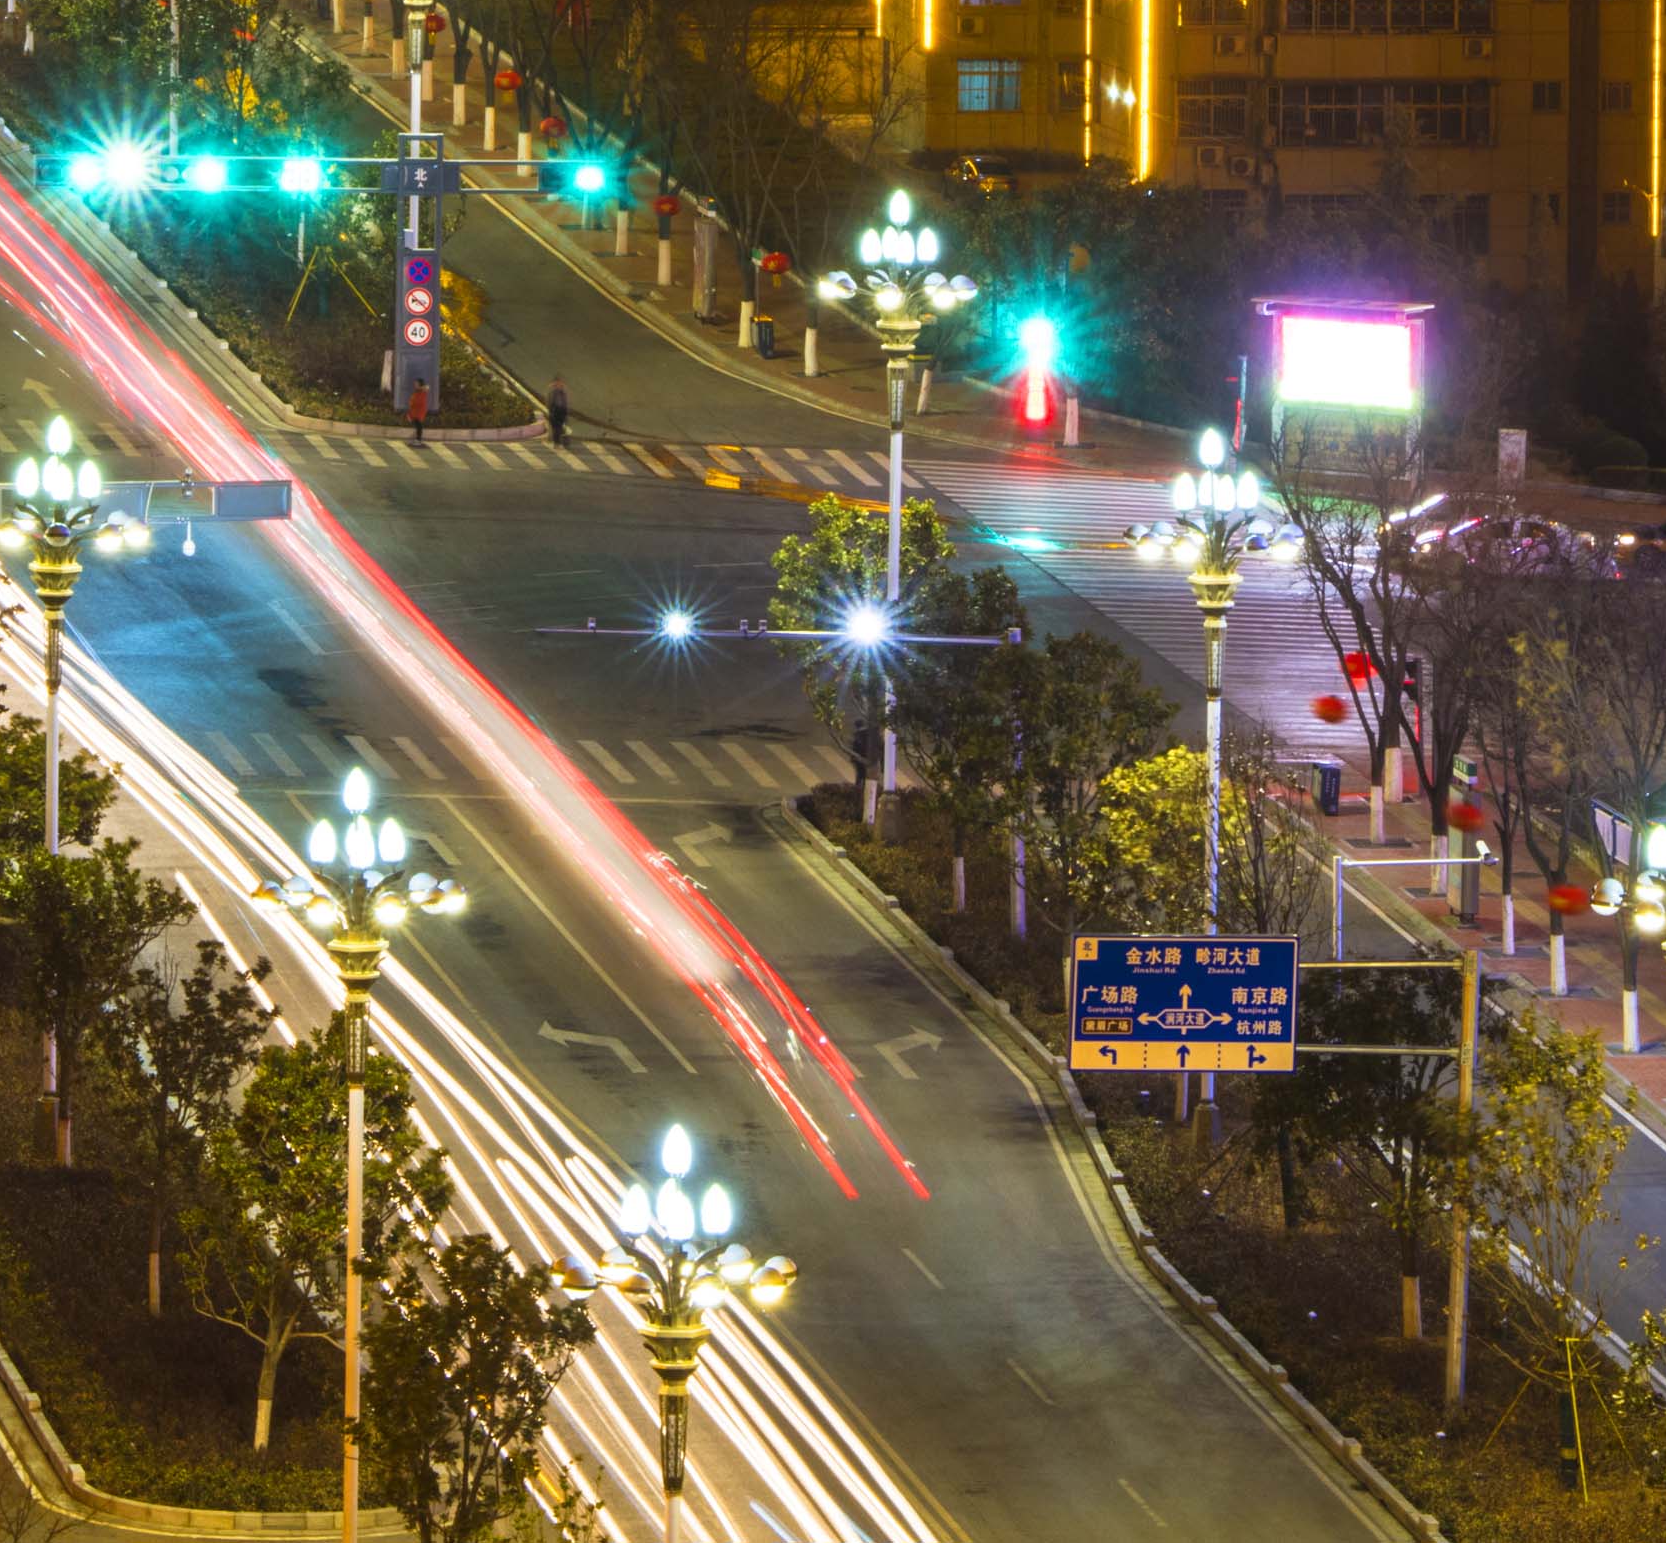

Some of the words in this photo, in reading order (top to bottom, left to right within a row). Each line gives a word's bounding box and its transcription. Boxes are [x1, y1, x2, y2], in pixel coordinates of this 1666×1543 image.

[413, 167, 428, 182] 北
[411, 326, 426, 338] 40
[1083, 941, 1092, 951] 北
[1125, 946, 1182, 966] 金水路
[1196, 947, 1261, 966] 畛河大道
[1081, 985, 1138, 1004] 广场路
[1231, 987, 1288, 1006] 南京路
[1165, 1012, 1205, 1025] 涧河大道
[1236, 1019, 1283, 1036] 杭州路
